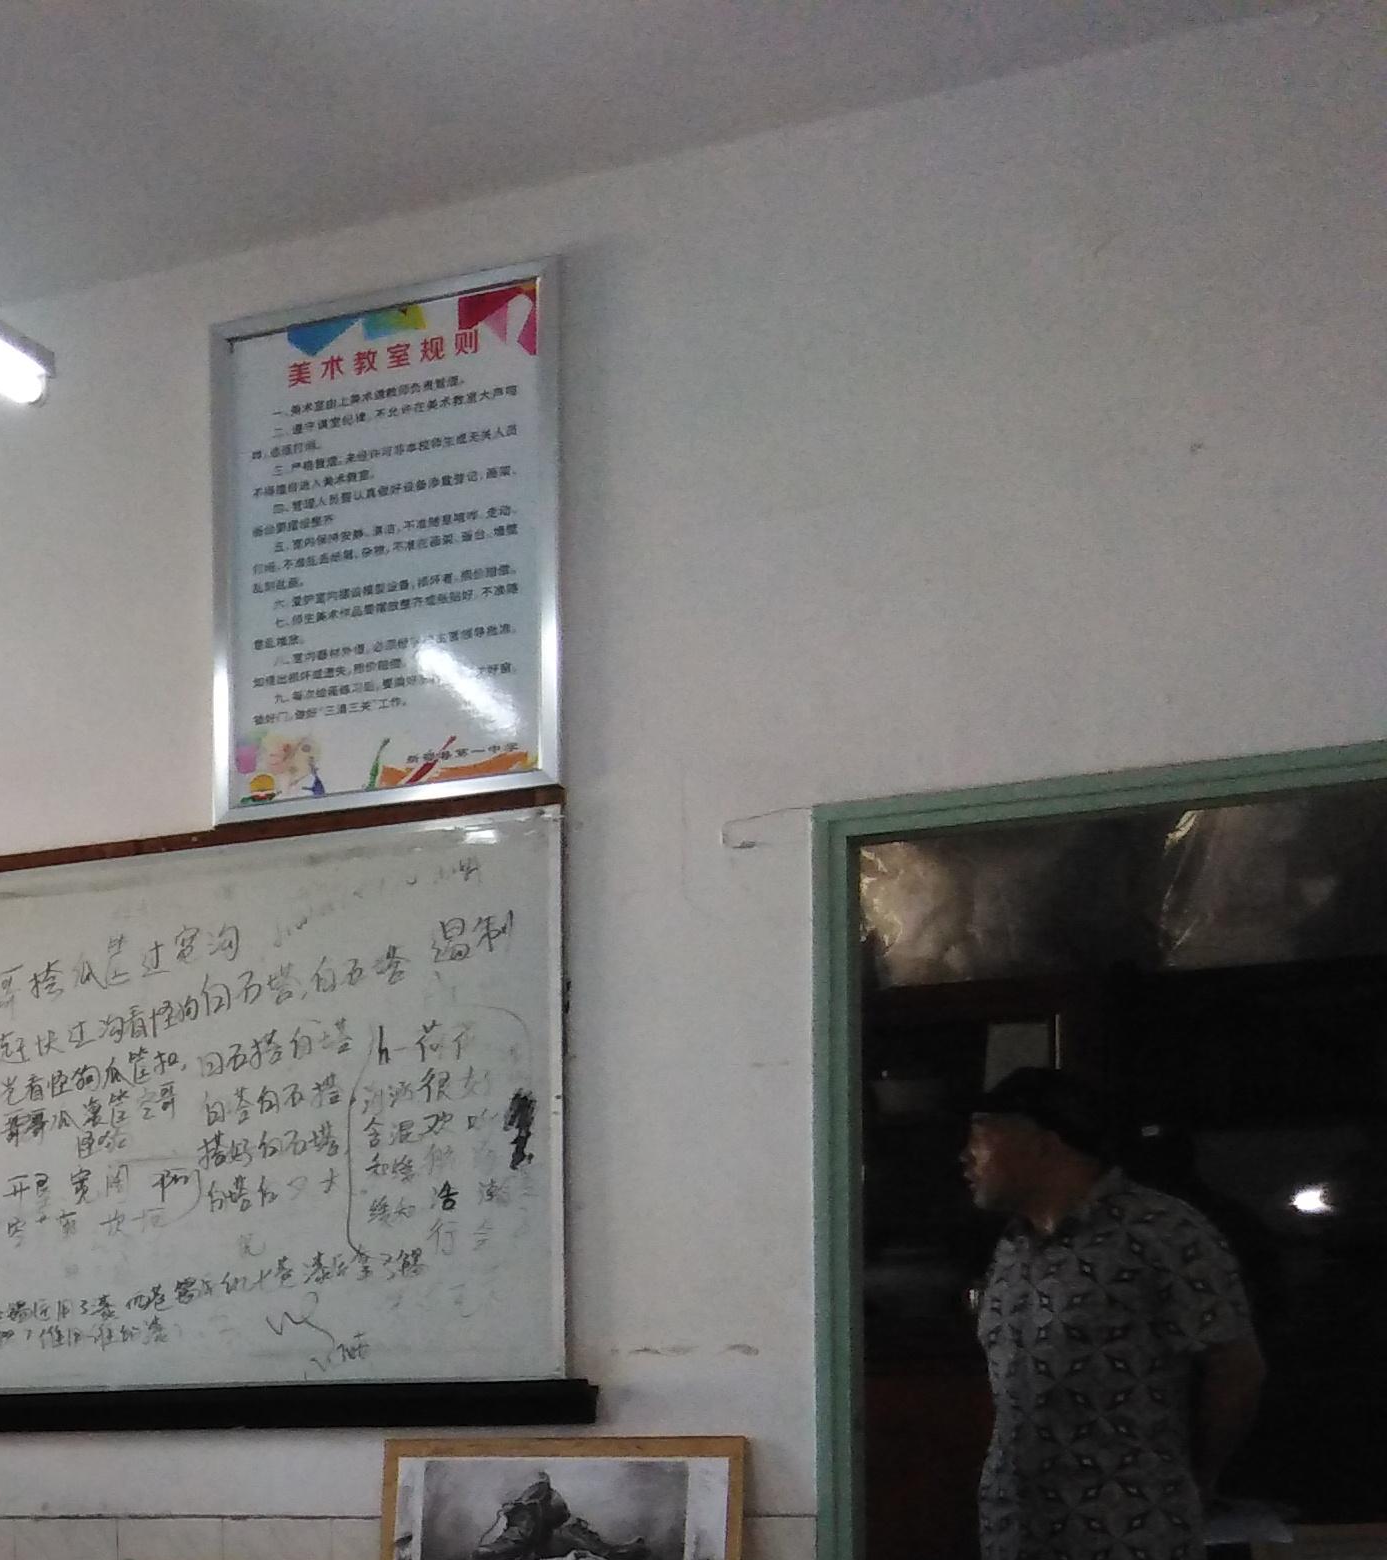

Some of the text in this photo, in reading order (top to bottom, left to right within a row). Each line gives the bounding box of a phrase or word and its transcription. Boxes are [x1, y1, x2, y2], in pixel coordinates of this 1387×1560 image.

[287, 327, 480, 389] 美术教室规则
